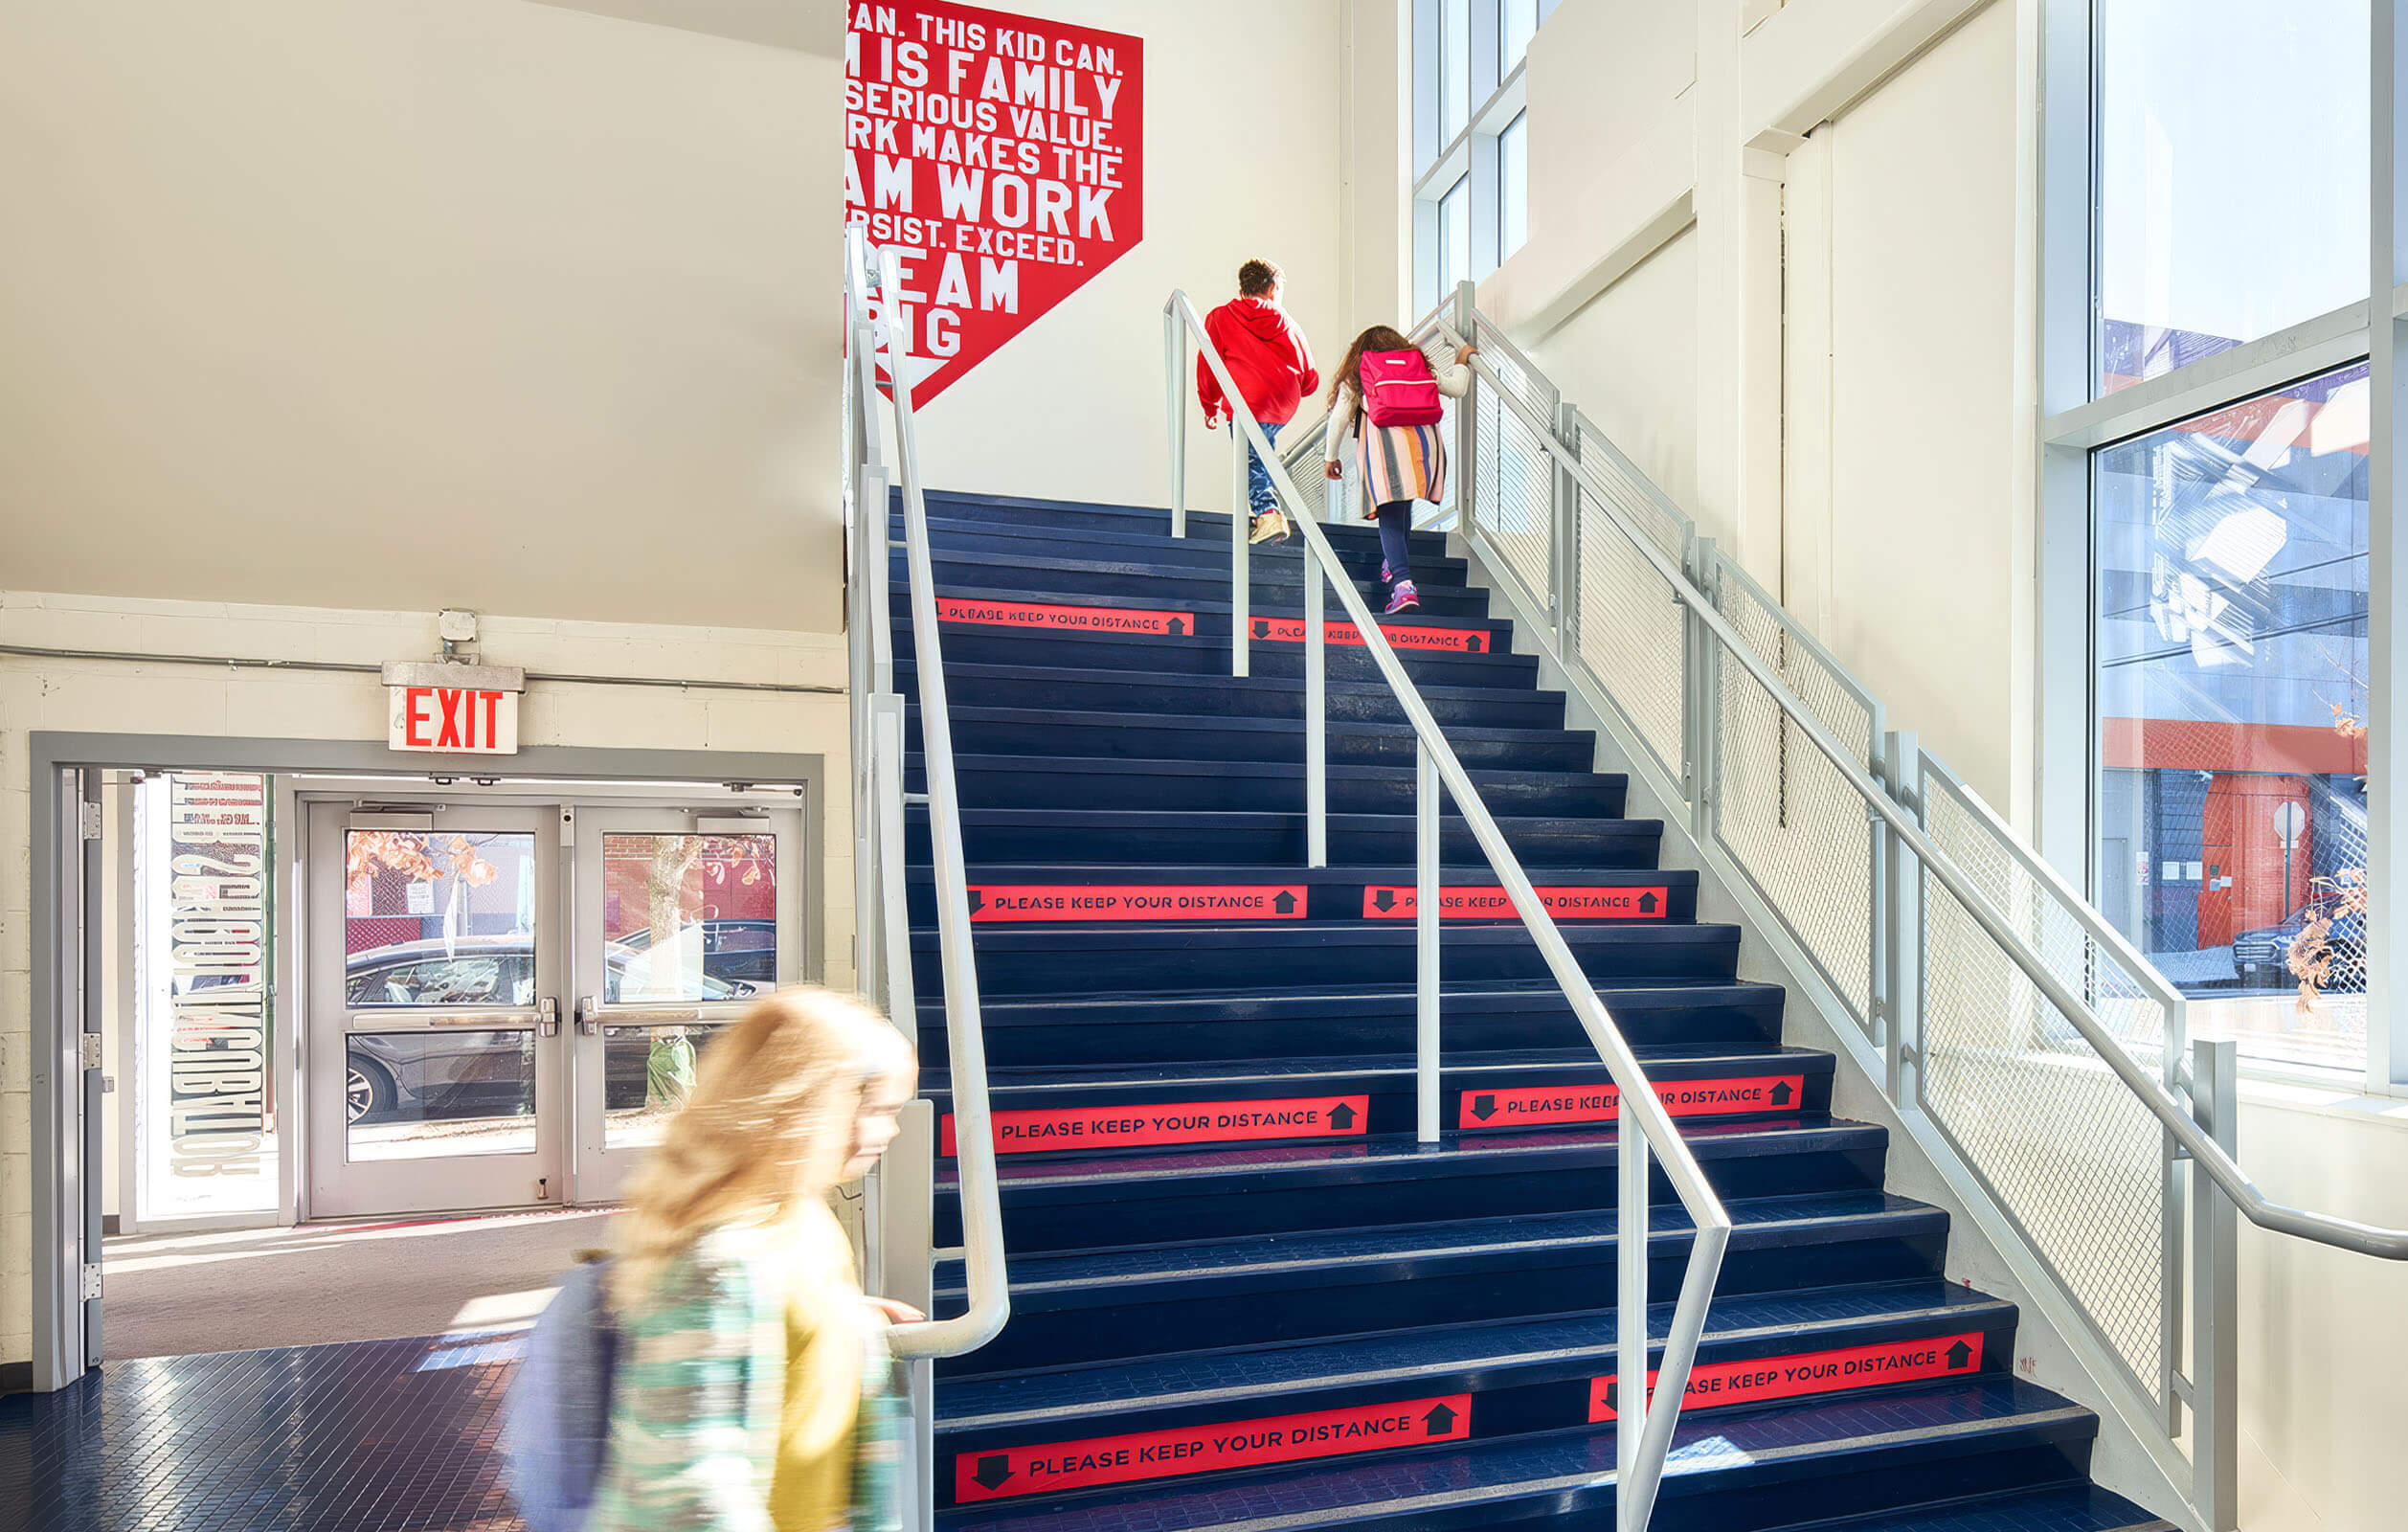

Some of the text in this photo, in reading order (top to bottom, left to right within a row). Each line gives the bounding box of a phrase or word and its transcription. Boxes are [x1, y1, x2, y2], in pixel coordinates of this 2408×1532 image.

[846, 2, 1124, 76] AN. THIS KID CAN.
[880, 36, 929, 88] IS
[948, 49, 1122, 121] FAMILY
[844, 79, 1122, 154] SERIOUS VALUE.
[911, 124, 1041, 176] MAKES
[1052, 146, 1123, 189] THE
[936, 163, 1114, 242] WORK
[847, 208, 1085, 267] RSIST. EXCEED.
[949, 607, 1160, 630] PLEASE KEEP YOUR DISTANCE
[405, 687, 504, 750] EXIT
[995, 895, 1265, 910] PLEASE KEEP YOUR DISTANCE
[1468, 896, 1507, 908] KEEP
[1558, 896, 1631, 908] DISTANCE
[1001, 1111, 1318, 1139] PLEASE KEEP YOUR DISTANCE
[1508, 1097, 1574, 1114] PLEASE
[1680, 1088, 1763, 1104] DISTANCE
[1728, 1370, 1778, 1390] KEEP
[1784, 1363, 1838, 1383] YOUR
[1843, 1350, 1937, 1376] DISTANCE
[1028, 1414, 1411, 1477] PLEASE KEEP YOUR DISTANCE
